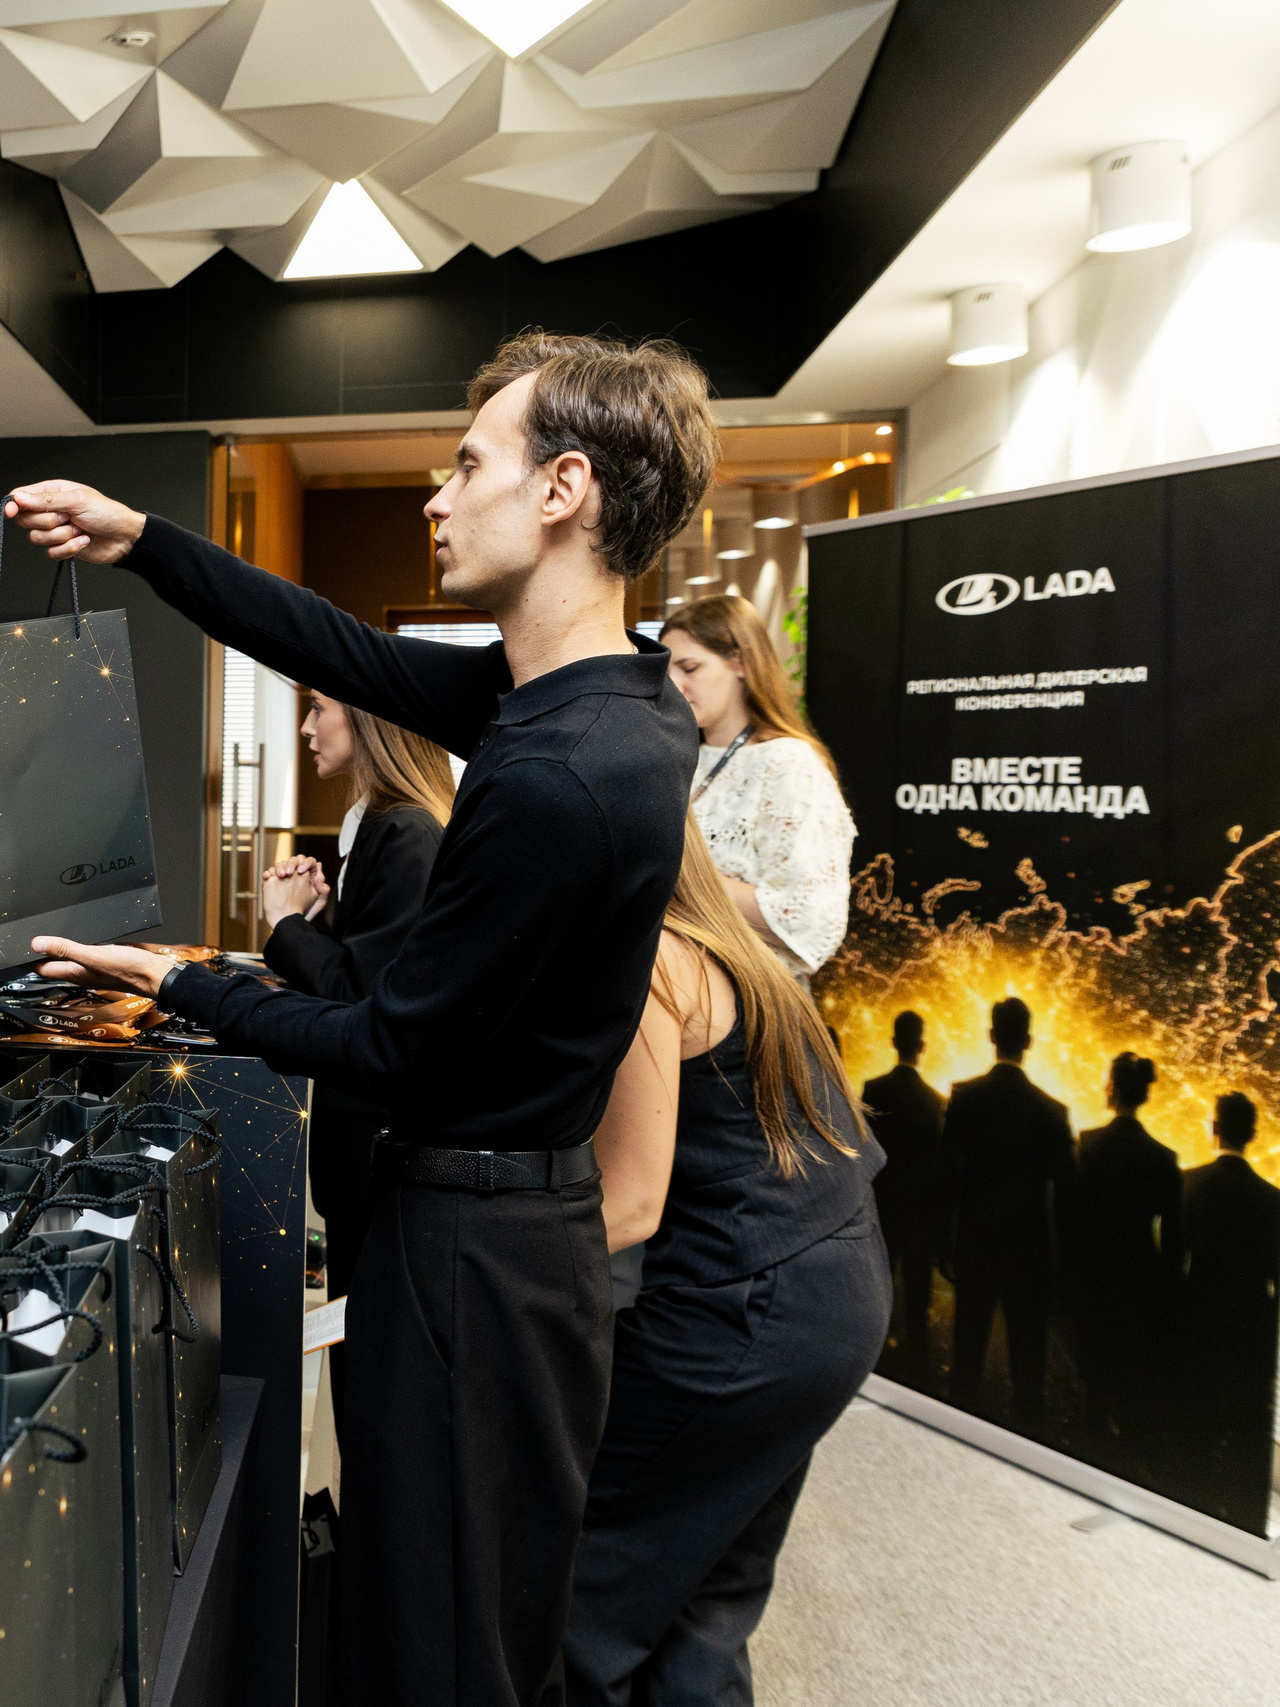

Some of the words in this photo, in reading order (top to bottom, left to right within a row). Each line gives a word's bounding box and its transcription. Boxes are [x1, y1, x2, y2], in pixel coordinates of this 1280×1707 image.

[1023, 566, 1116, 601] LADA
[907, 673, 1036, 695] РЕГИОНАЛЬНАЯ
[1034, 666, 1148, 689] ДИЛЕРСКАЯ
[955, 691, 1085, 711] КОНФЕРЕНЦИЯ
[951, 757, 1082, 784] ВМЕСТЕ
[895, 783, 978, 815] ОДНА
[981, 785, 1151, 819] КОМАНДА
[100, 856, 136, 874] LADA
[59, 1020, 79, 1029] LADA
